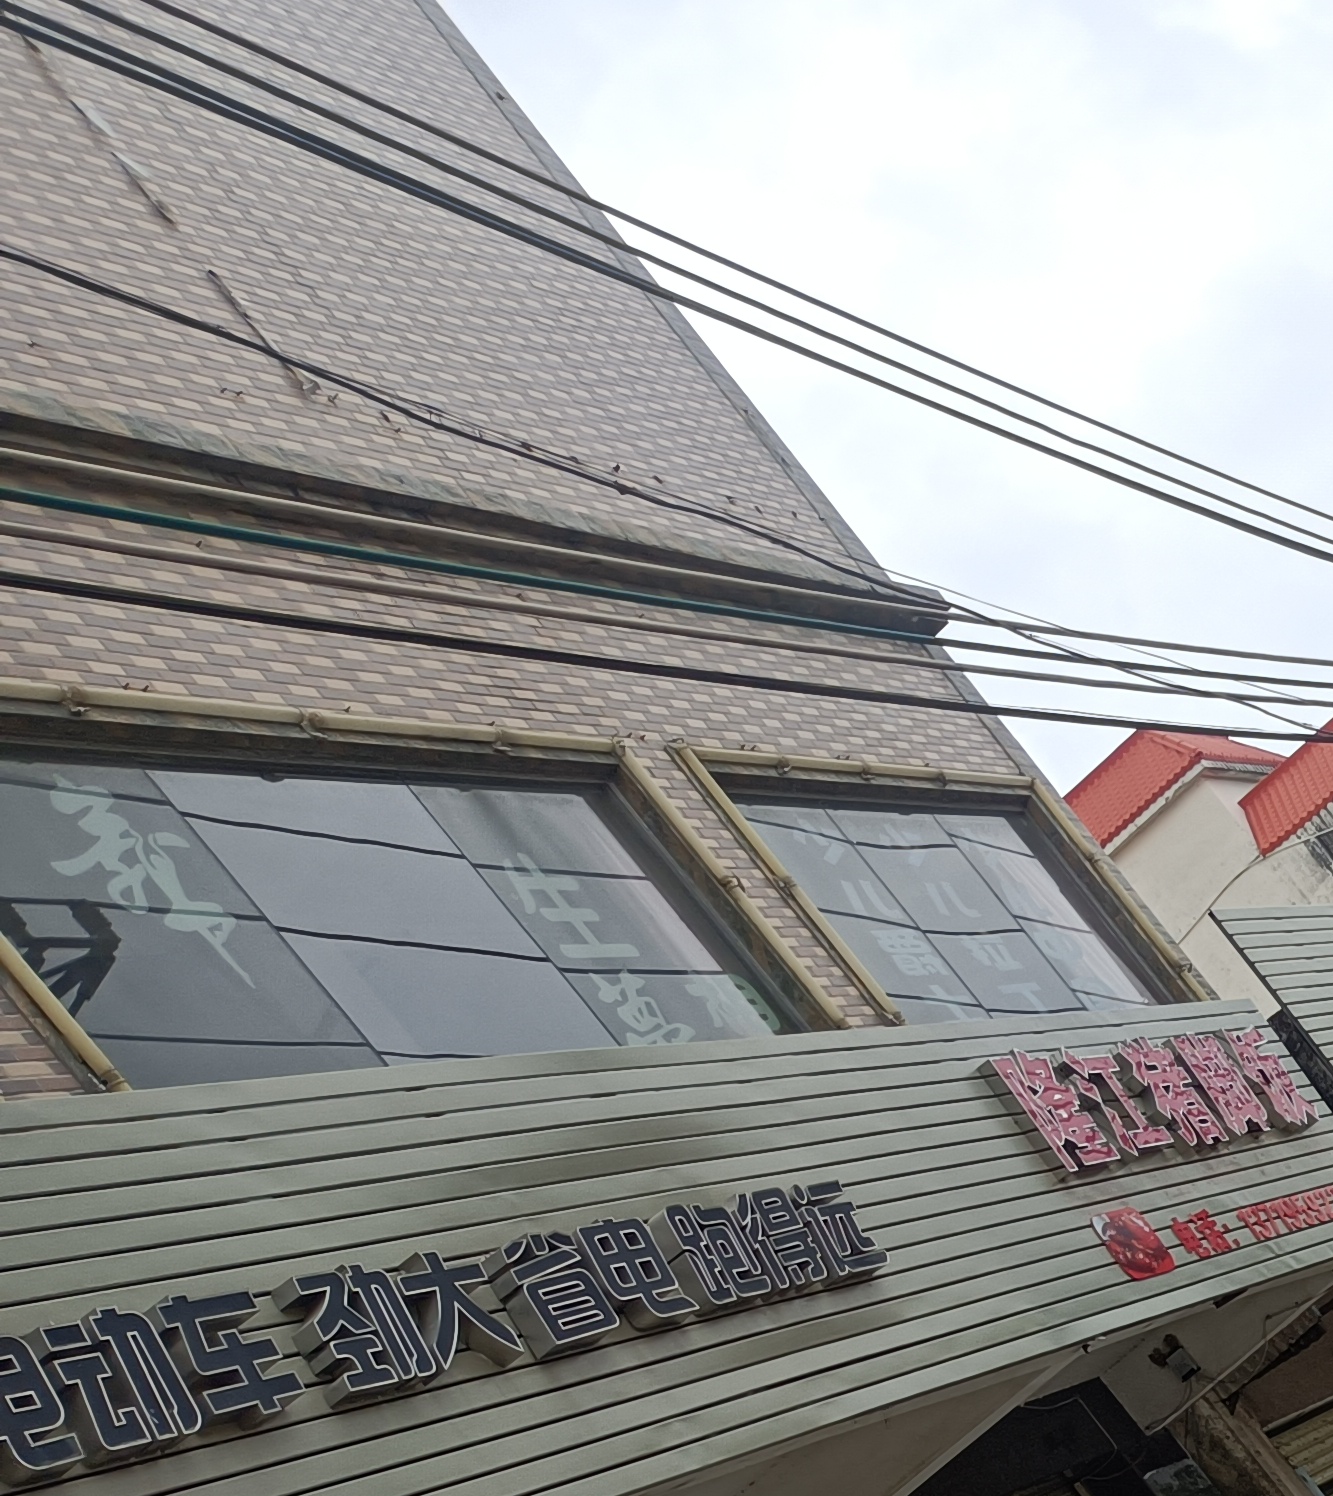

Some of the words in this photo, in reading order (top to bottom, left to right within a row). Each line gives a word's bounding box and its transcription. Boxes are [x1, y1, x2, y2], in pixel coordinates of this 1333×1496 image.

[987, 1022, 1321, 1172] 隆江猪脚饭
